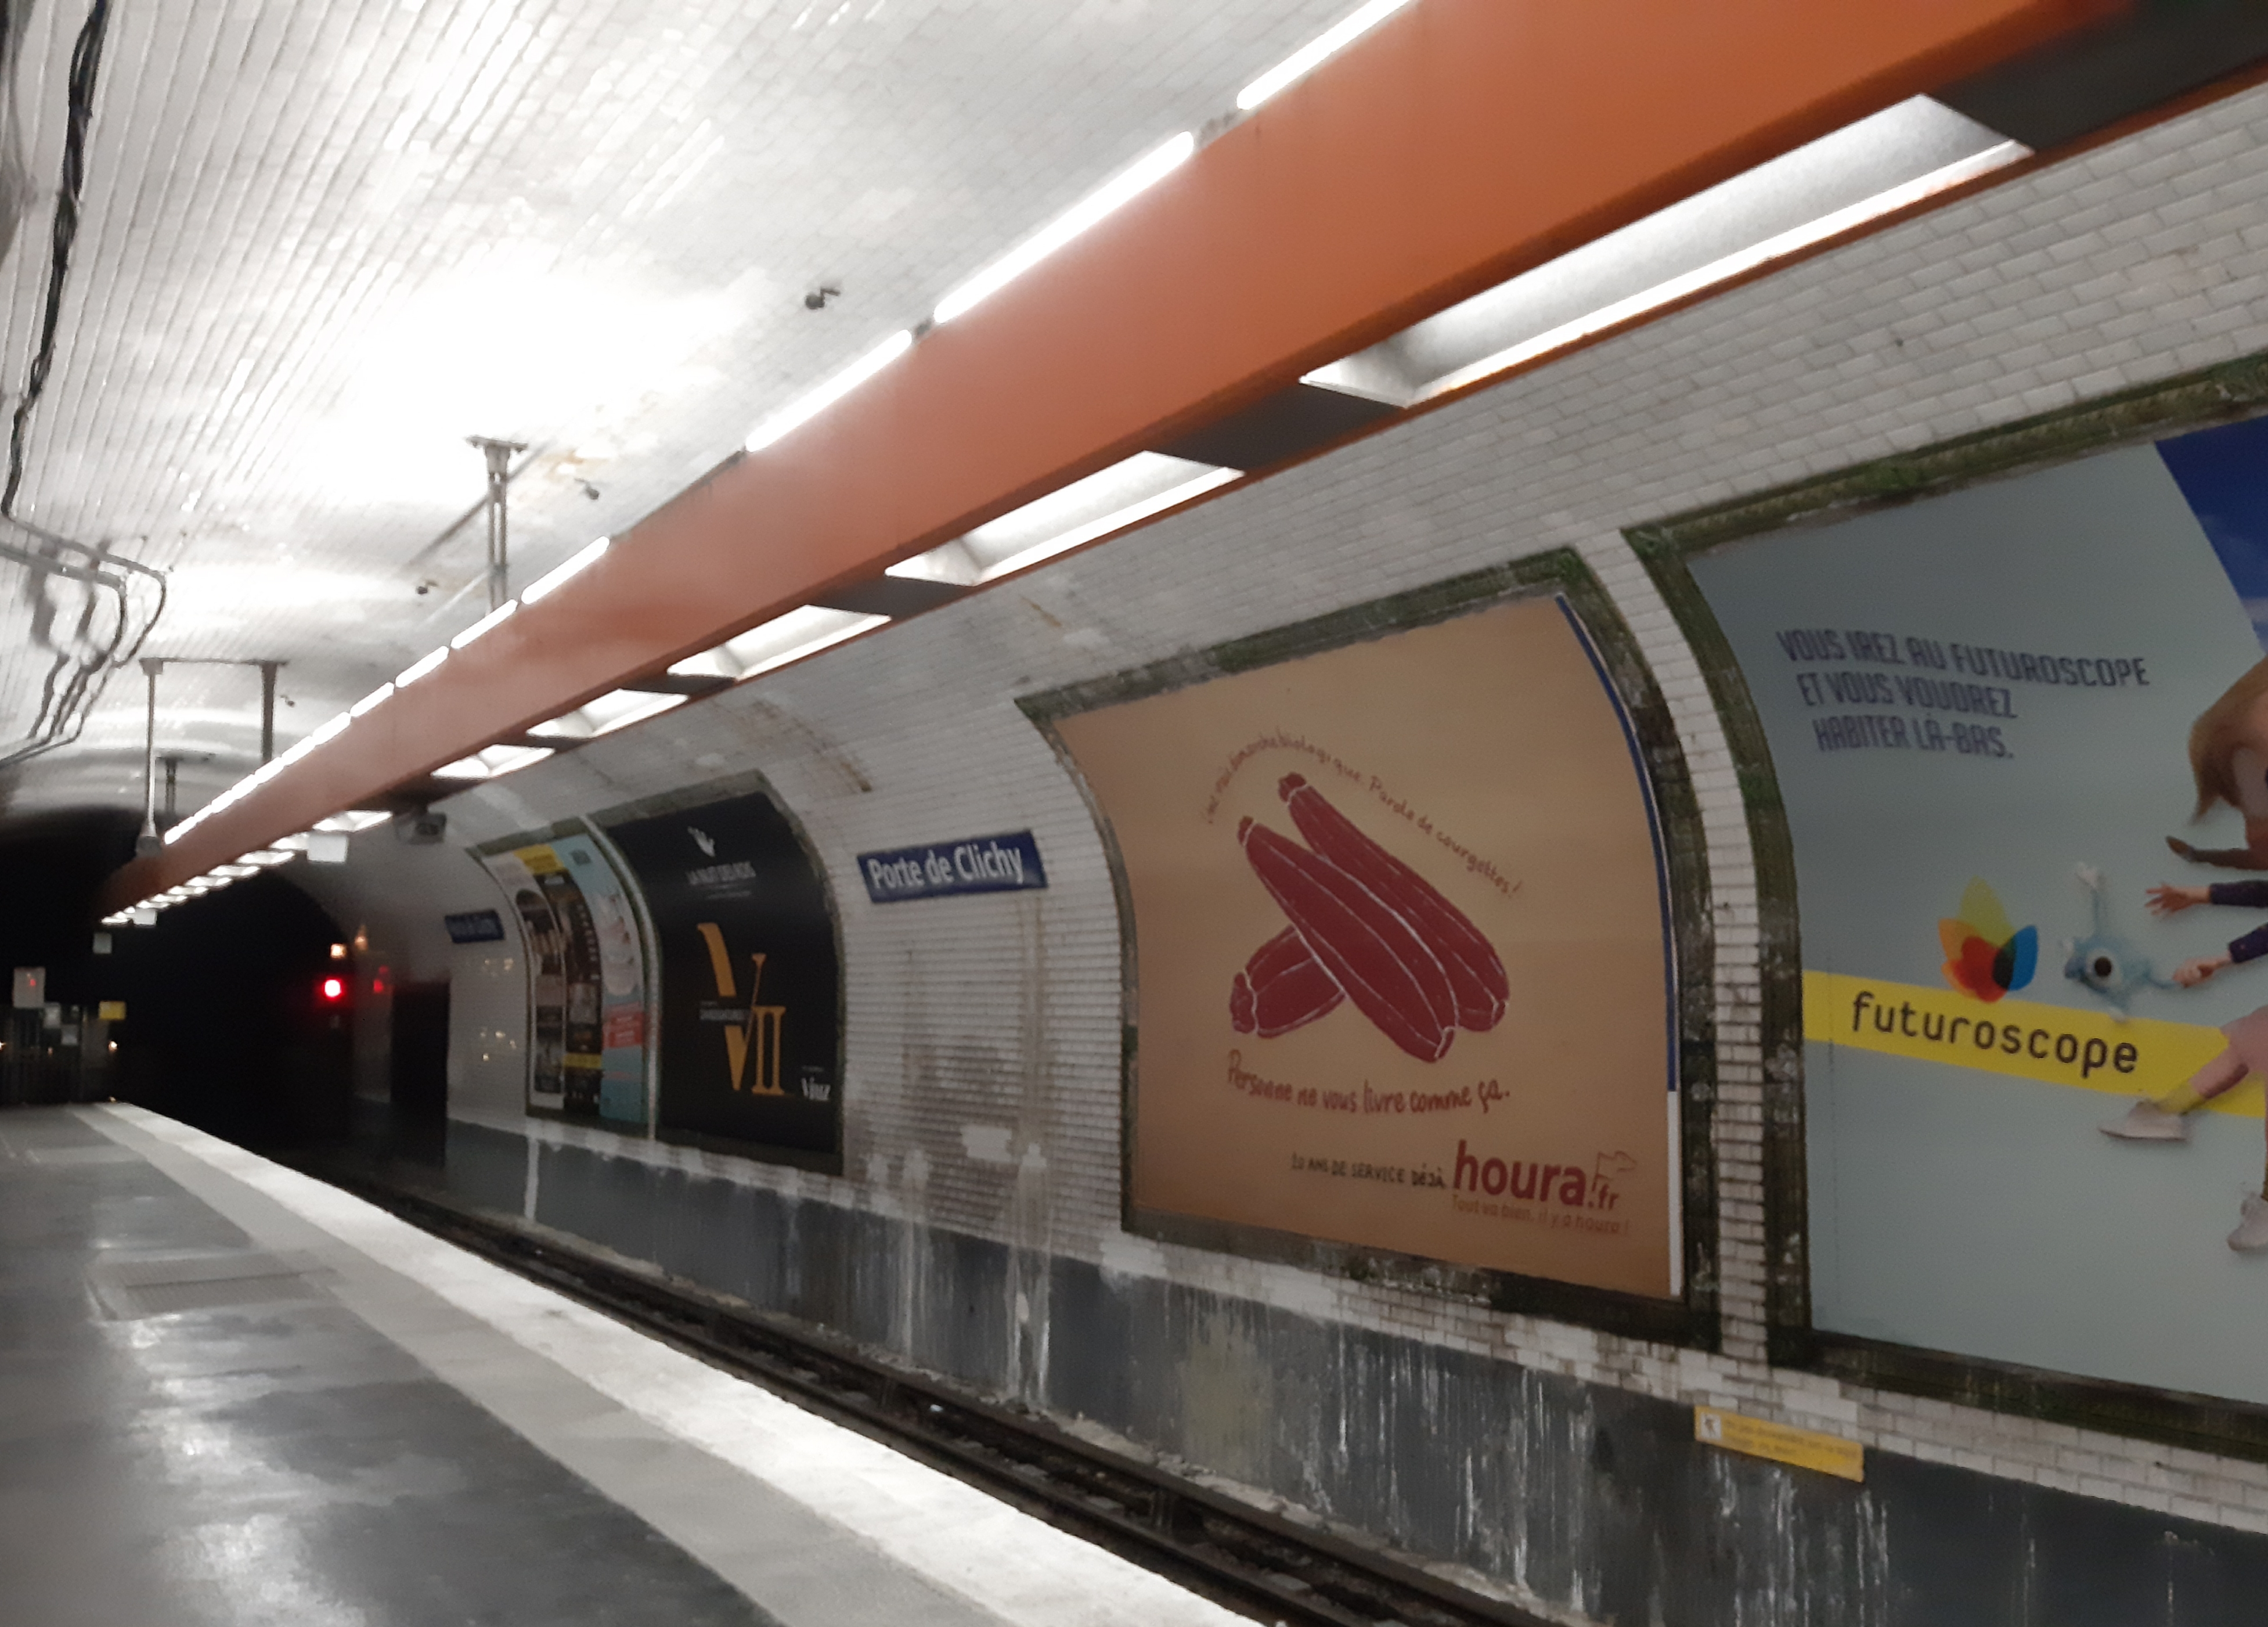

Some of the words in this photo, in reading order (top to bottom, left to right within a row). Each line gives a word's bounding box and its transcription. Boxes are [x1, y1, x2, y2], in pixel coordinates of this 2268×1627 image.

[1775, 629, 1847, 662] VOUS
[1845, 631, 1905, 665] IREZ
[1906, 636, 1946, 671] AU
[1949, 642, 2150, 687] FUTUROSCOPE
[1797, 672, 1825, 707] ET
[1825, 671, 1894, 704] VOUS
[1893, 675, 2019, 719] VOUDREZ
[1812, 714, 1912, 752] HABITER
[1369, 775, 1415, 821] Parole
[1416, 815, 1433, 834] de
[867, 857, 925, 889] Porte
[924, 848, 954, 884] de
[953, 840, 1024, 884] Clichy
[1851, 990, 2139, 1078] futuroscope
[1228, 1049, 1292, 1102] Personne
[1297, 1086, 1318, 1107] ne
[1322, 1089, 1357, 1113] vous
[1364, 1078, 1407, 1114] livre
[1409, 1085, 1473, 1113] comme
[1477, 1079, 1510, 1114] ça.
[1307, 1157, 1329, 1174] ANS
[1331, 1160, 1347, 1177] DE
[1351, 1162, 1406, 1184] SERVICE
